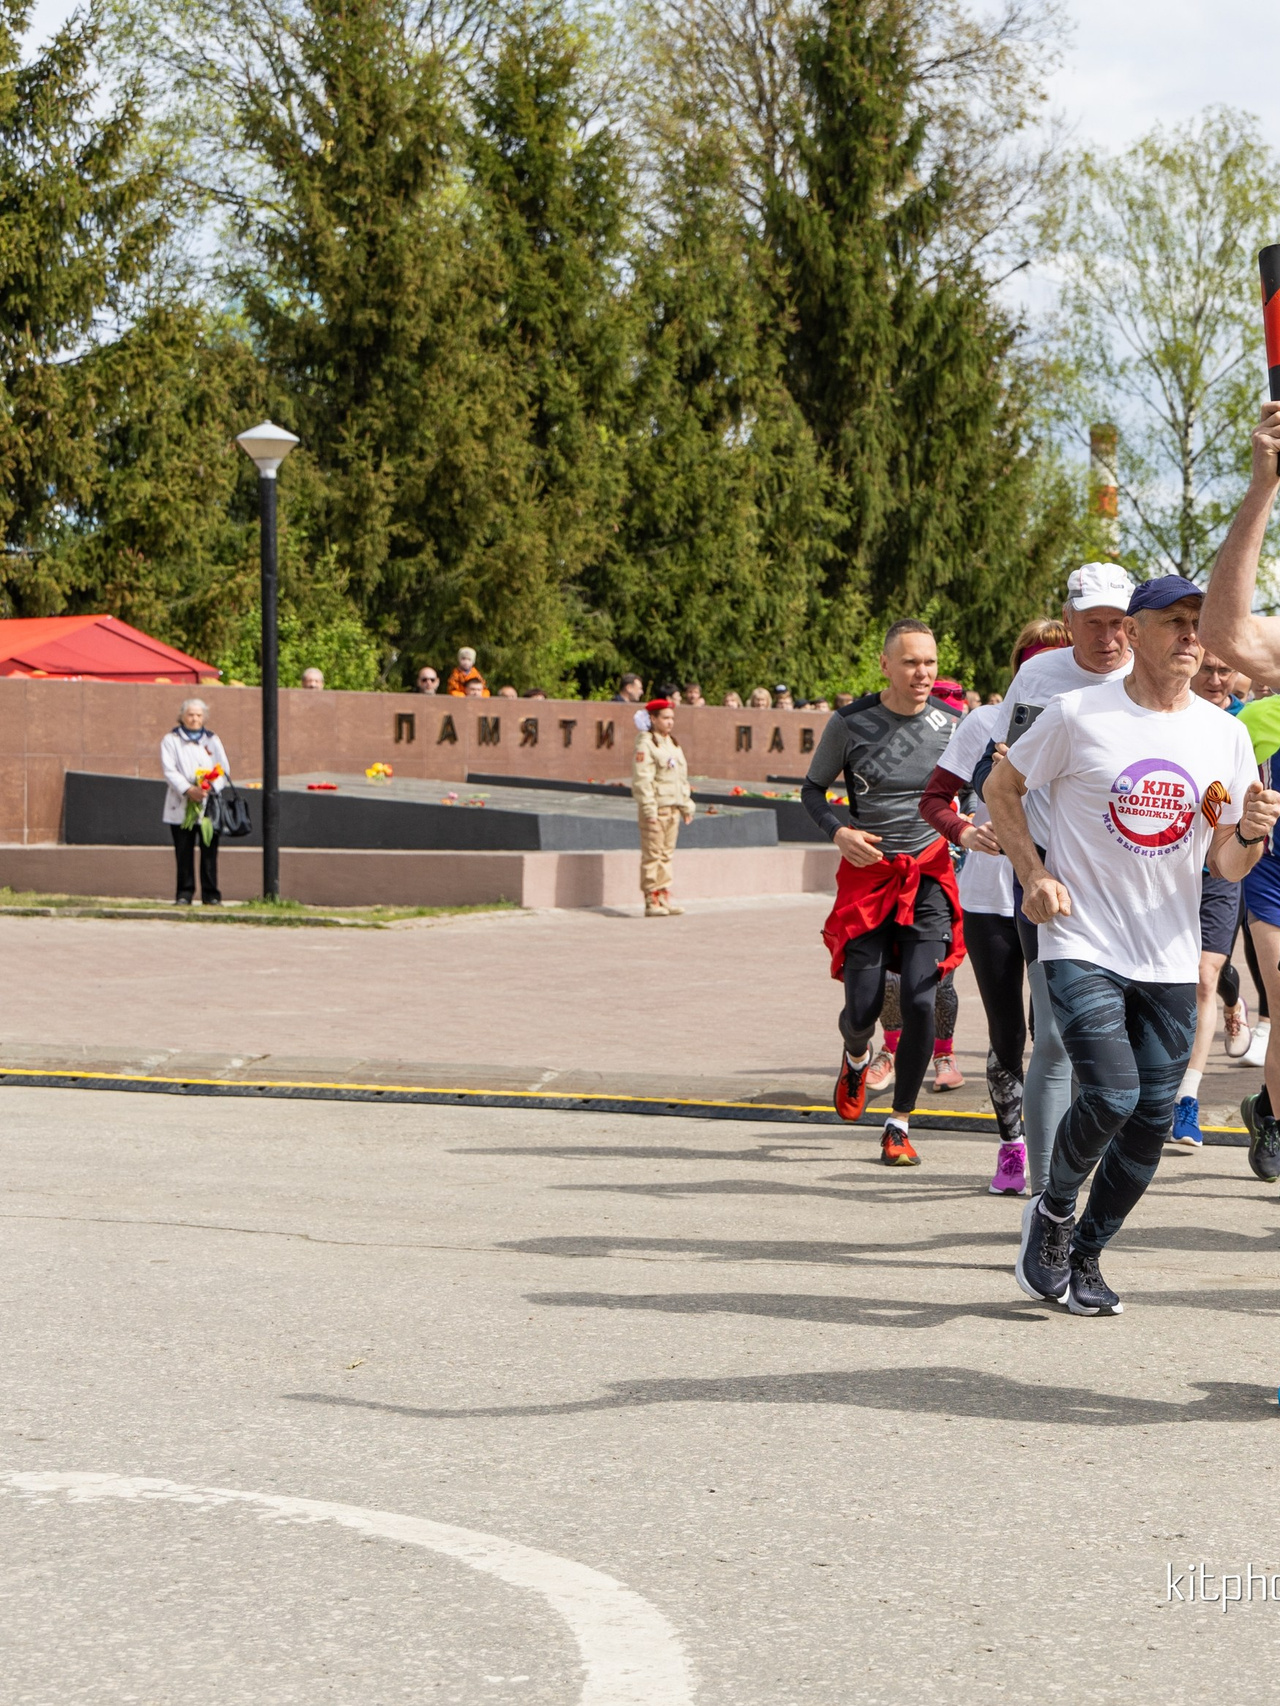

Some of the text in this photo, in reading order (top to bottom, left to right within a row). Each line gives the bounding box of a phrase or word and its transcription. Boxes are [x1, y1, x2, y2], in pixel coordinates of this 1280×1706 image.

[394, 712, 615, 750] ПАМЯТИ
[735, 725, 815, 754] ПАВ
[1142, 779, 1185, 798] КЛБ
[1117, 794, 1192, 811] «ОЛЕНЬ»
[1118, 805, 1175, 820] ЗАВОЛЖЬЕ
[1102, 812, 1115, 835] Мы
[1116, 833, 1181, 858] выбираем
